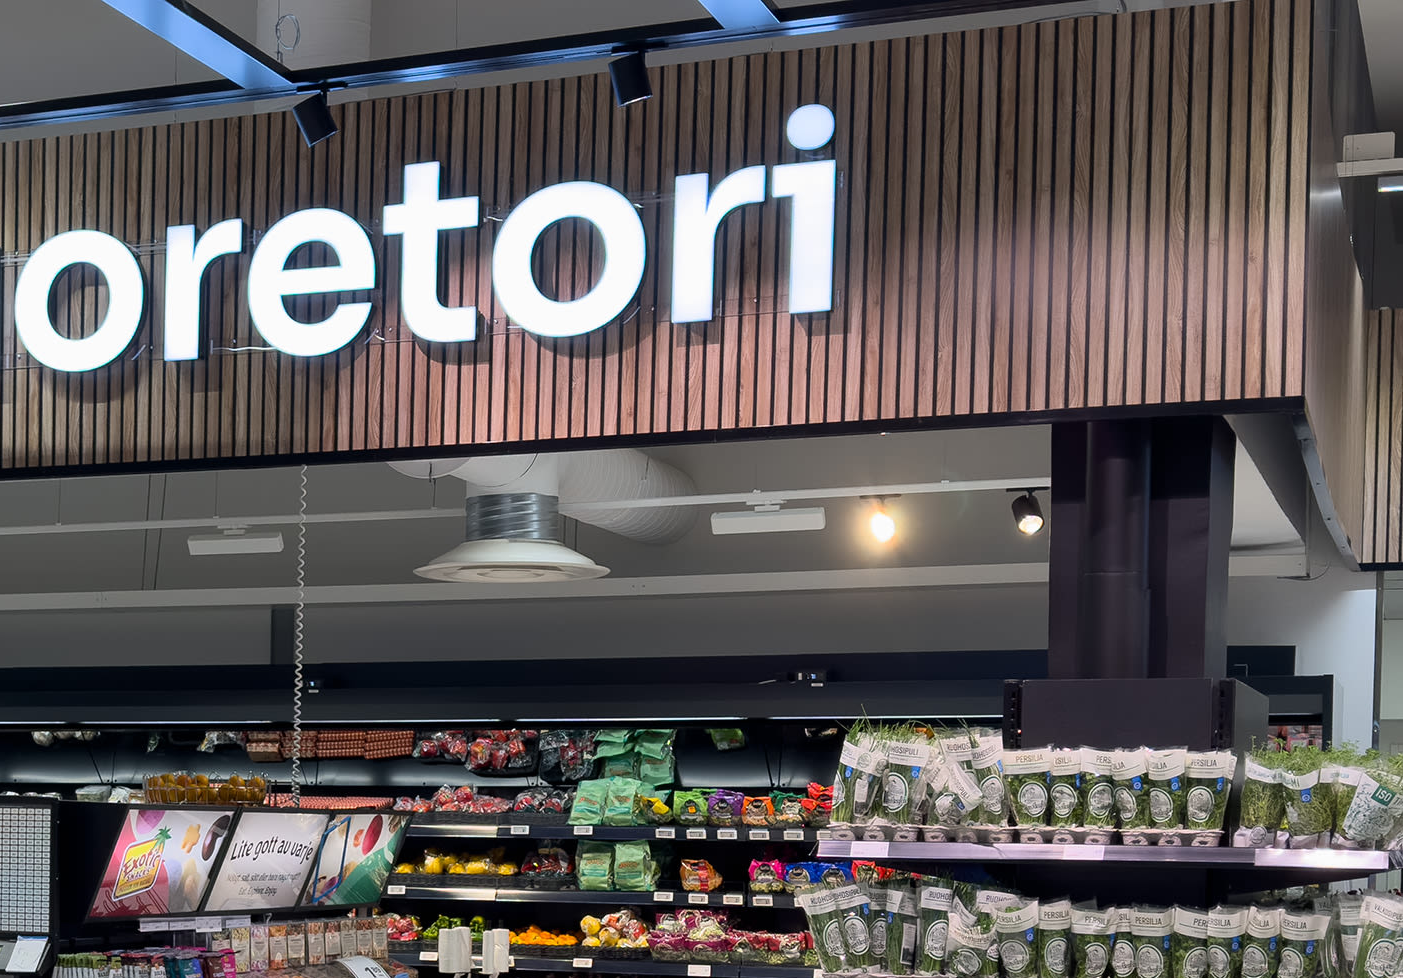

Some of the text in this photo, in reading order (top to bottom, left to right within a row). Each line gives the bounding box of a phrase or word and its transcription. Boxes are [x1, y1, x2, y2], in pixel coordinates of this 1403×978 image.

[1015, 753, 1044, 764] PERSILJA
[1375, 788, 1393, 802] ISO
[230, 840, 254, 861] Lite
[253, 836, 279, 861] gott
[1134, 916, 1163, 926] PERSILJA
